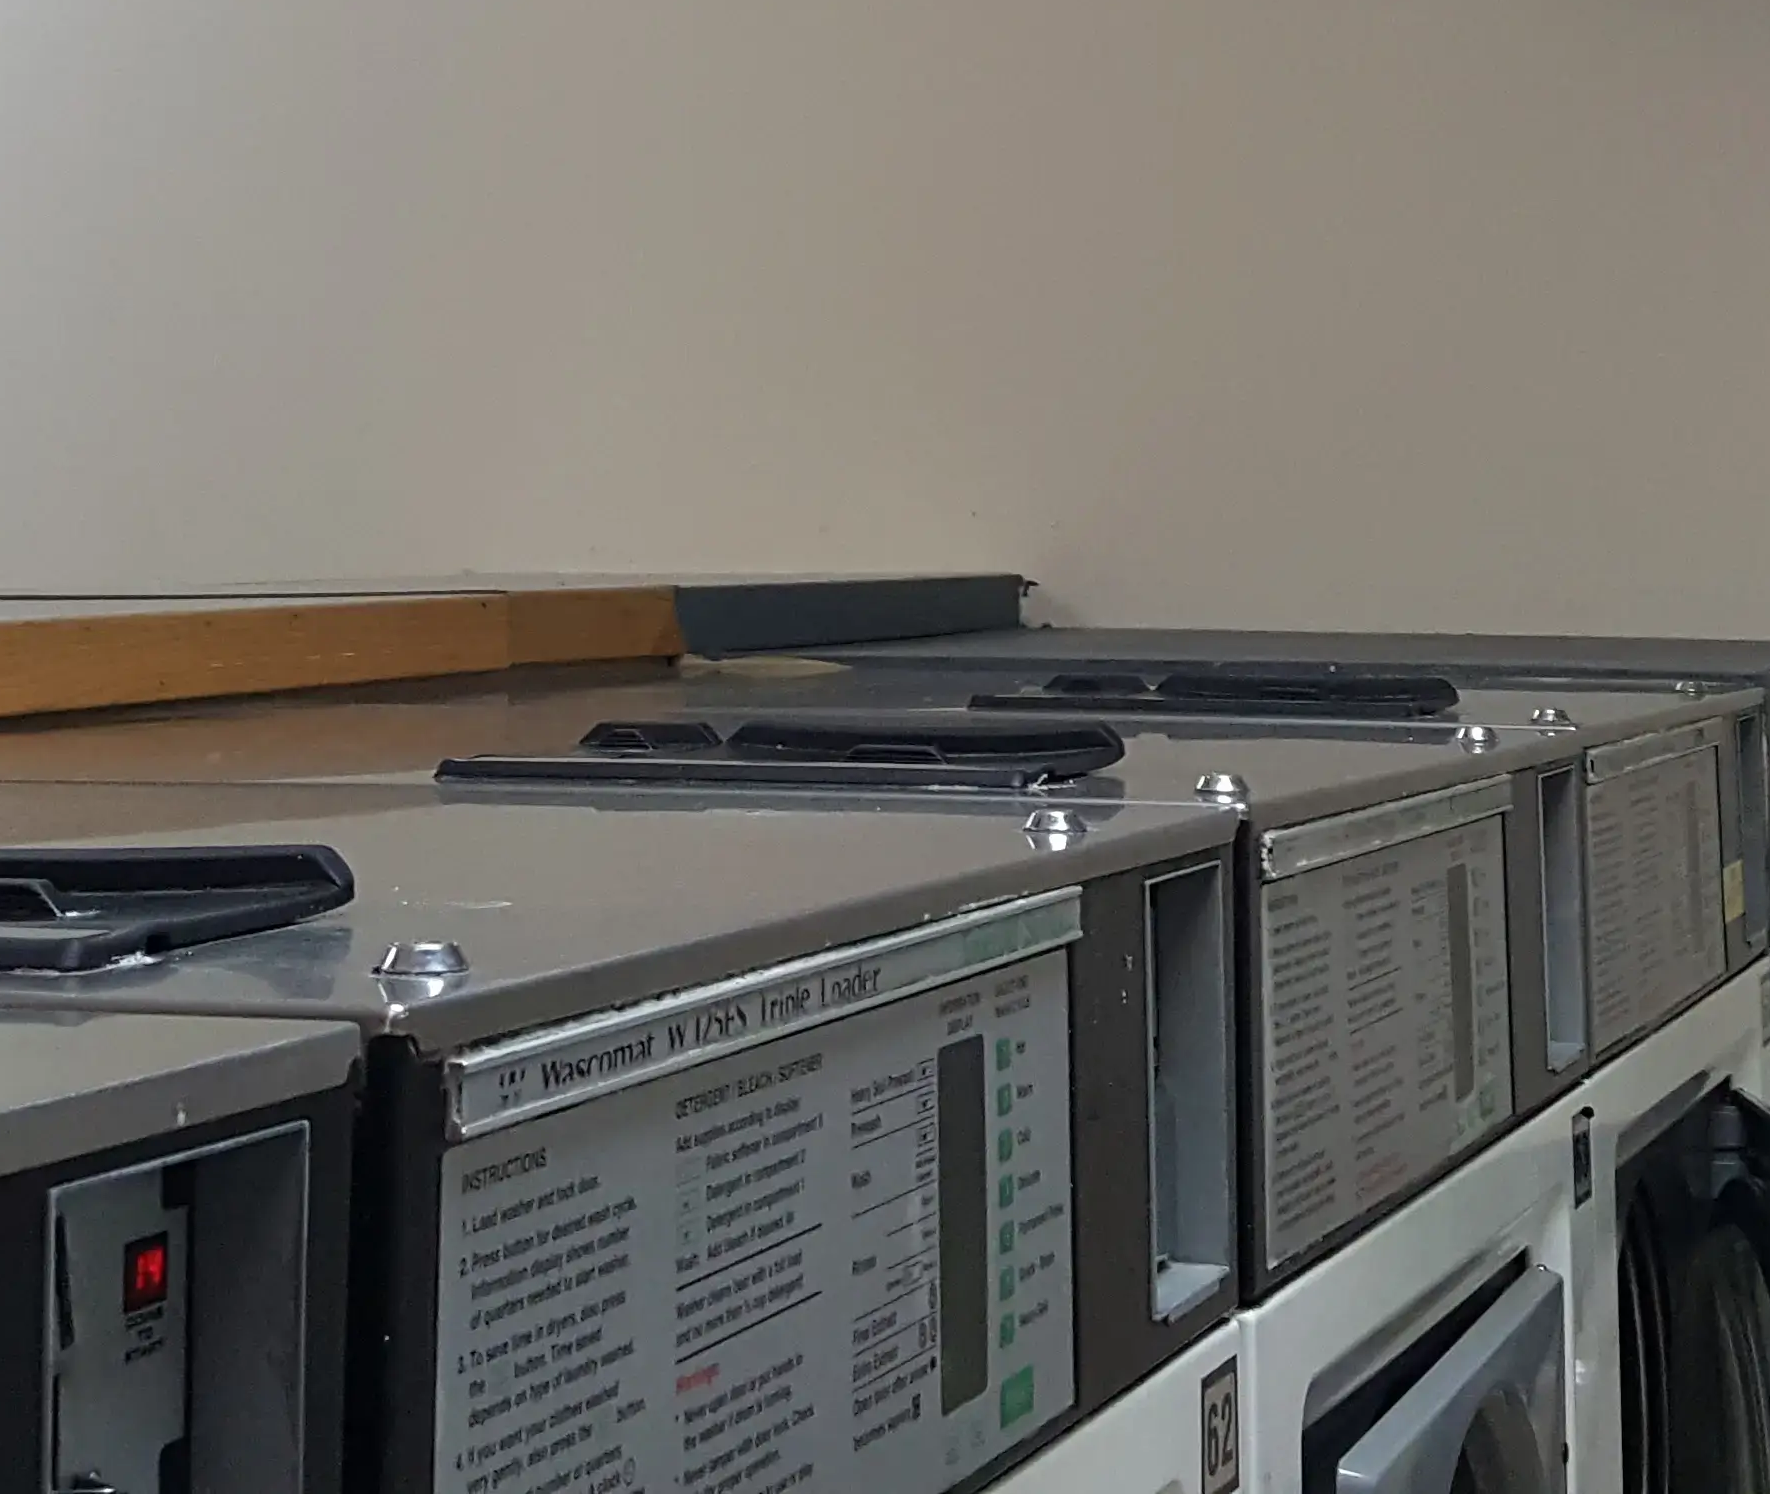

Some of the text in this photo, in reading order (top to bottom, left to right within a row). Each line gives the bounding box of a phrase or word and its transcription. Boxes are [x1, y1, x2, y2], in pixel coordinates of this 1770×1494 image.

[541, 1034, 656, 1092] Wascomat
[759, 983, 811, 1028] Triple
[819, 965, 883, 1008] Loader
